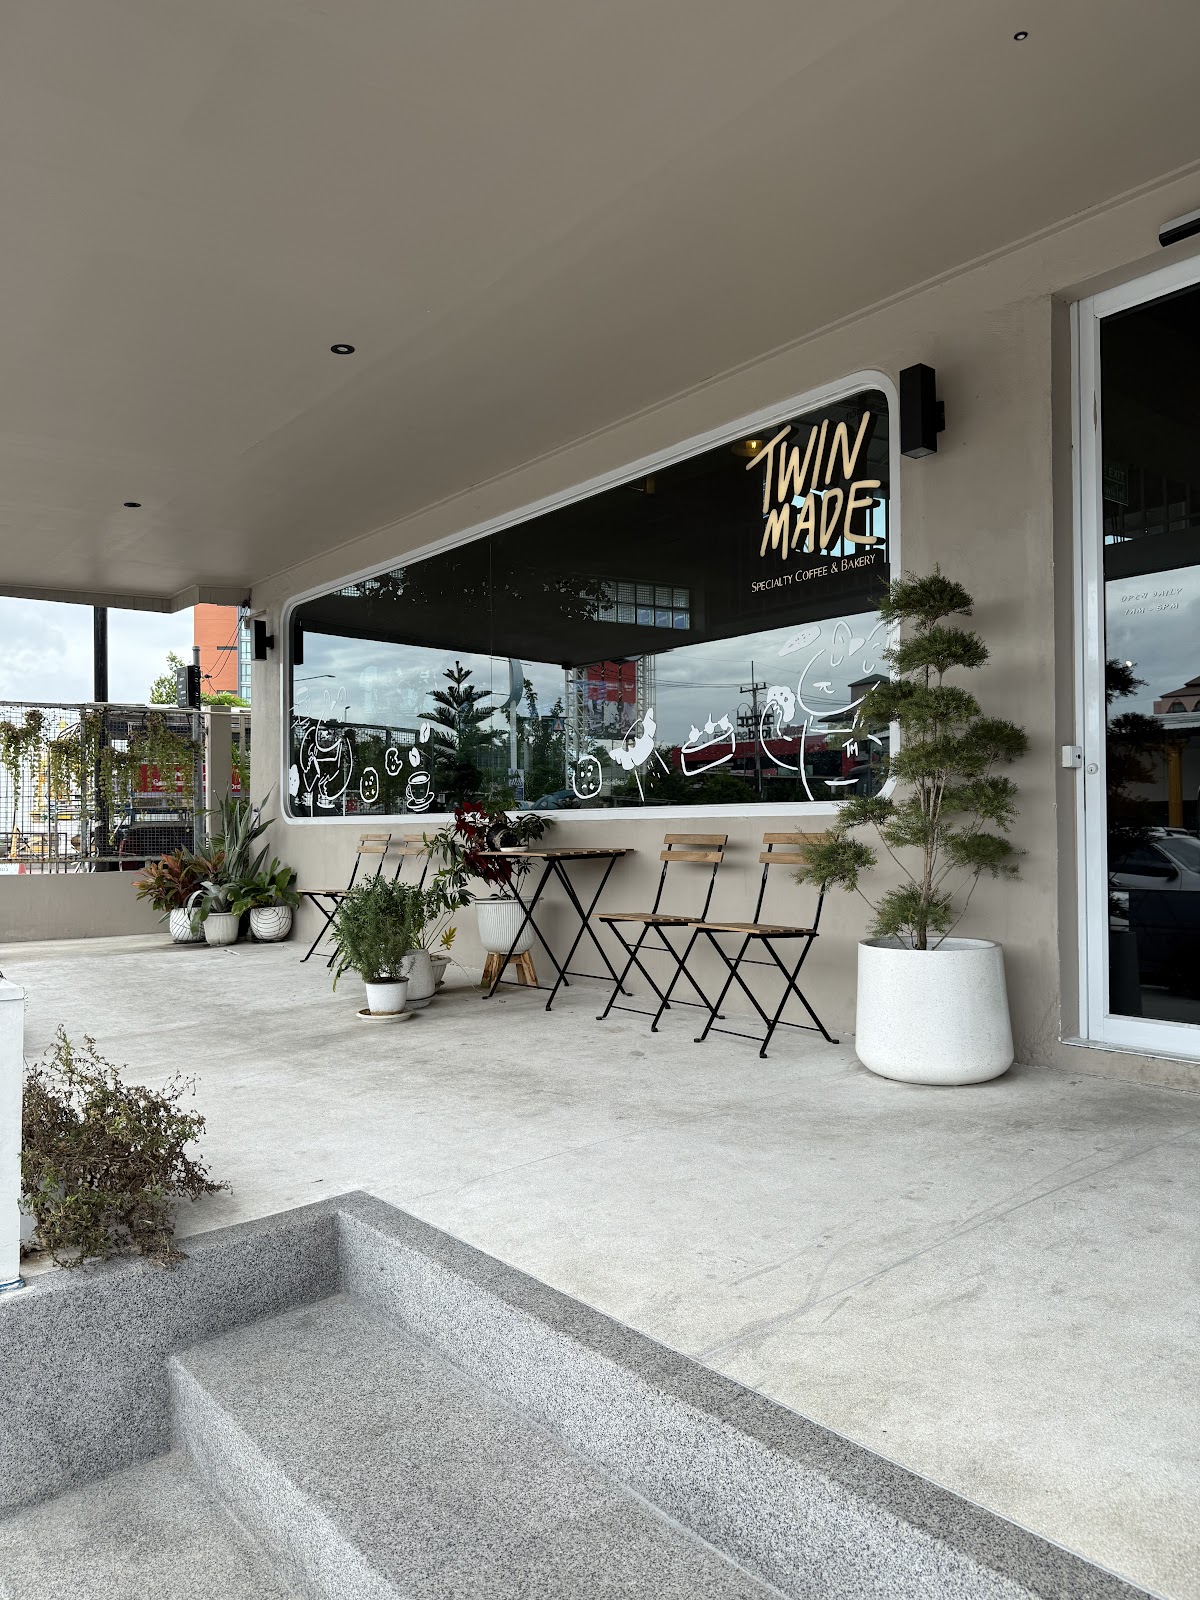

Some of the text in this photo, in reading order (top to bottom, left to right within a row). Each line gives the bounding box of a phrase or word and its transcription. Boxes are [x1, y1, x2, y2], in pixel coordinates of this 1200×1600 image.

[745, 411, 871, 513] TWIN
[760, 479, 881, 560] MADE
[751, 553, 876, 593] SPECIALTY COFFEE & BAKERY
[842, 738, 858, 758] TM
